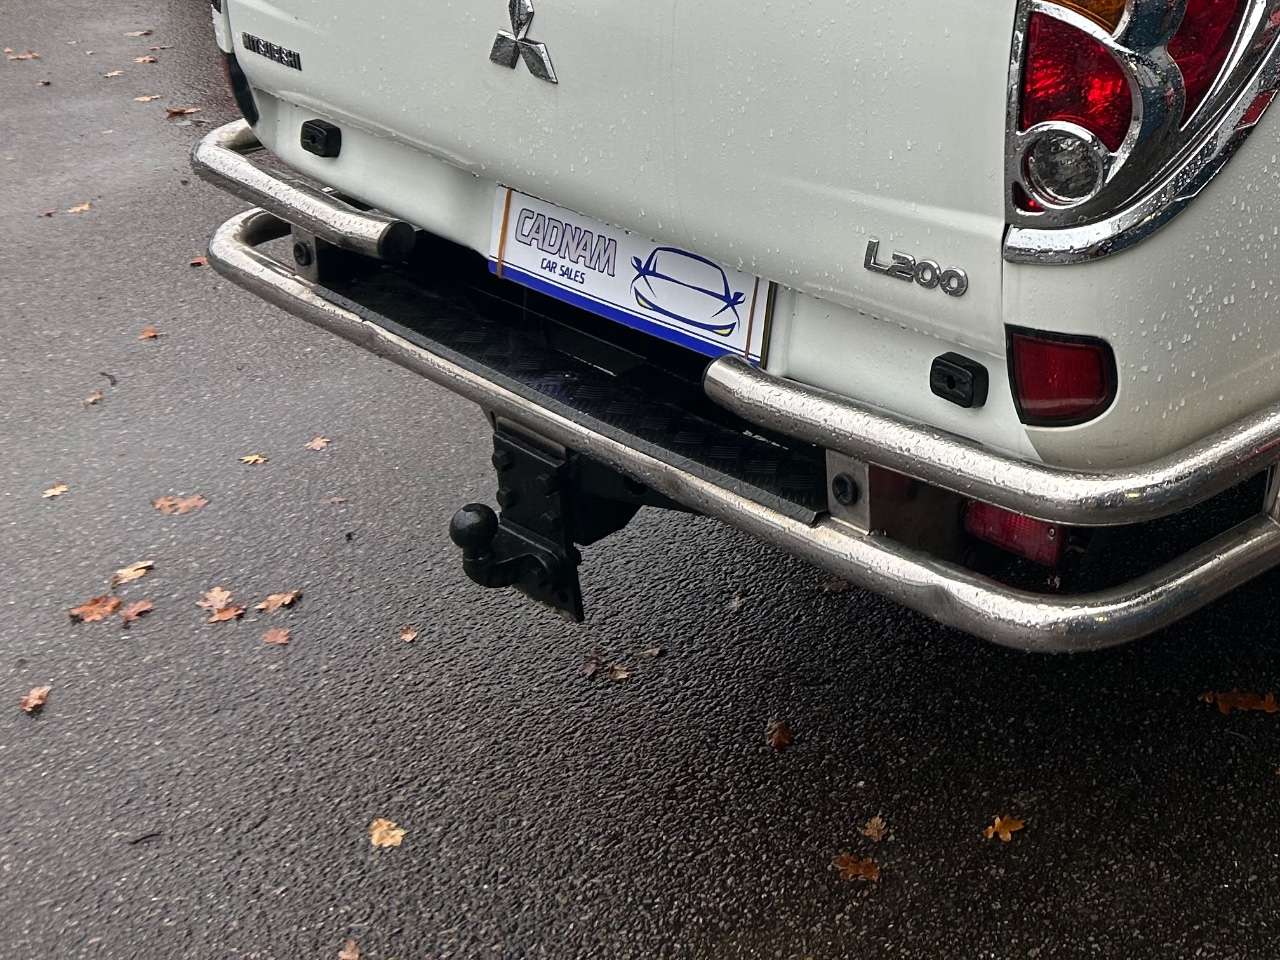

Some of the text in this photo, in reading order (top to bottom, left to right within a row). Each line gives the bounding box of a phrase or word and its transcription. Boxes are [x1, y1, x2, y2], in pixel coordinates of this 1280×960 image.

[515, 208, 618, 278] CADNAM
[540, 257, 586, 285] CAR SALES
[863, 239, 969, 297] L200
